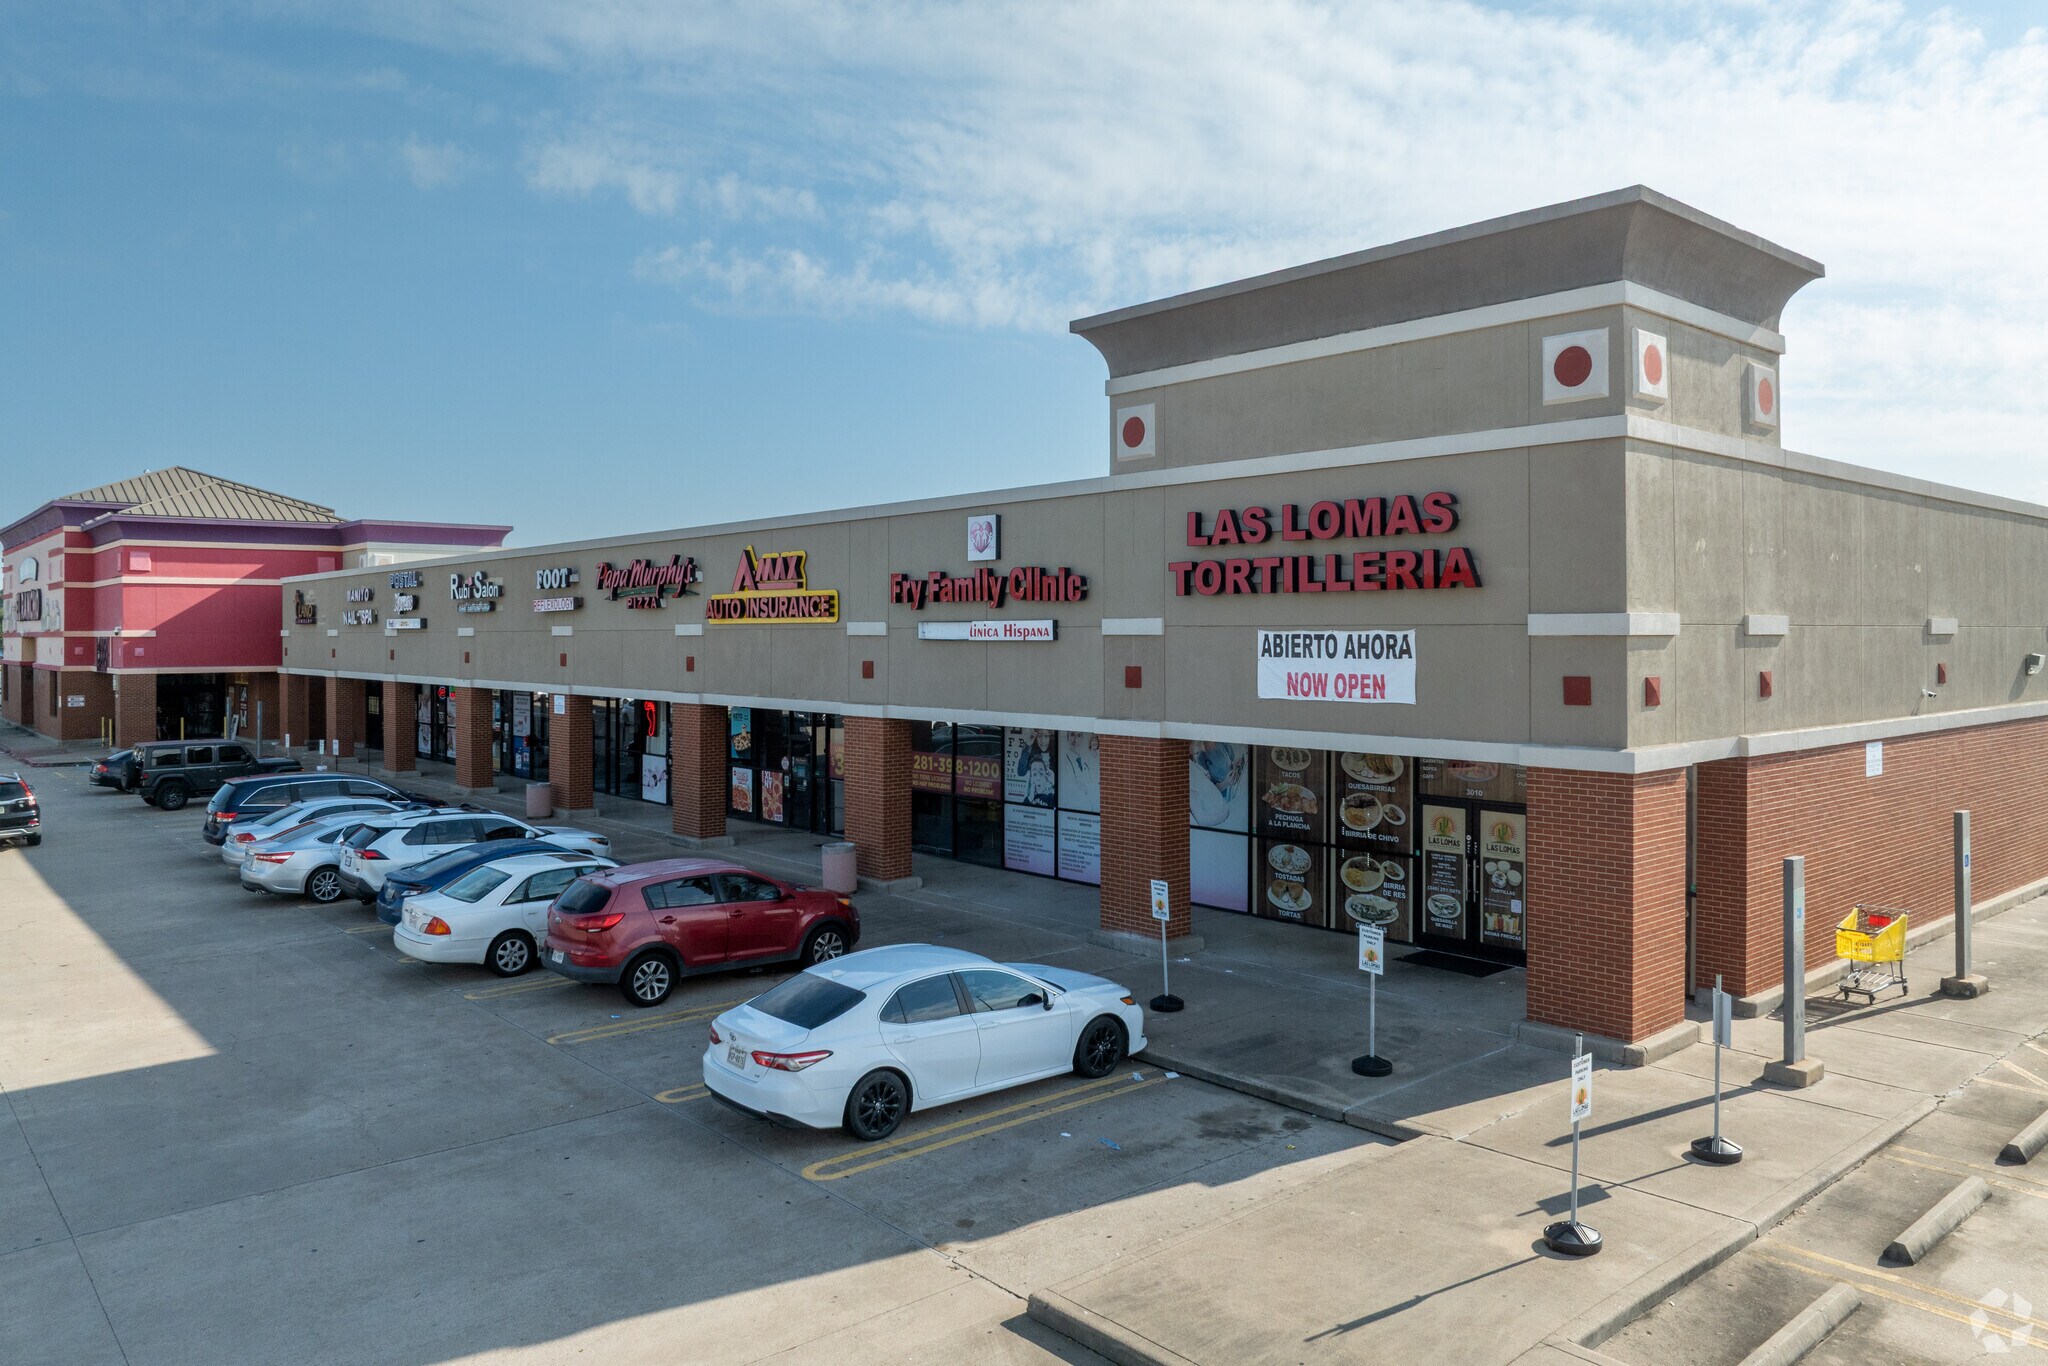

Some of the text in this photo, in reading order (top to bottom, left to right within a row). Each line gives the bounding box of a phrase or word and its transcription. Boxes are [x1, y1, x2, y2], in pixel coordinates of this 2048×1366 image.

[1187, 491, 1456, 547] LAS LOMAS
[596, 554, 692, 600] Papa Murphy's
[1168, 547, 1480, 596] TORTILLERIA
[390, 571, 418, 588] POSTAL
[536, 567, 569, 590] FOOT
[474, 571, 499, 599] Salon
[890, 566, 1083, 610] Fry Family Clinic
[533, 598, 574, 612] REFLEXOLOGY
[627, 596, 658, 609] PIZZA
[705, 596, 831, 619] AUTO INSURANCE
[1261, 633, 1413, 660] ABIERTO AHORA
[1286, 671, 1386, 700] NOW OPEN
[1281, 771, 1301, 779] TACOS
[1348, 782, 1396, 793] QUESABIRRIAS
[1465, 788, 1483, 797] 3010
[1275, 813, 1304, 823] PECHUGA
[1274, 820, 1282, 828] LA
[1282, 821, 1311, 831] PLANCHA
[1345, 830, 1399, 843] BIRRIA DE CHIVO
[1428, 836, 1461, 847] LAS LOMAS
[1486, 843, 1499, 852] LAS
[1499, 844, 1521, 855] LOMAS
[1274, 872, 1305, 883] TOSTADAS
[1383, 881, 1406, 891] BIRRIA
[1490, 887, 1516, 896] TORTILLAS
[1382, 889, 1406, 900] DE RES
[1278, 909, 1301, 919] TORTAS
[1430, 916, 1457, 925] QUESADILLA
[1361, 928, 1382, 936] CUSTOMER
[1500, 932, 1522, 941] FRESCAS
[1363, 934, 1380, 942] PARKING
